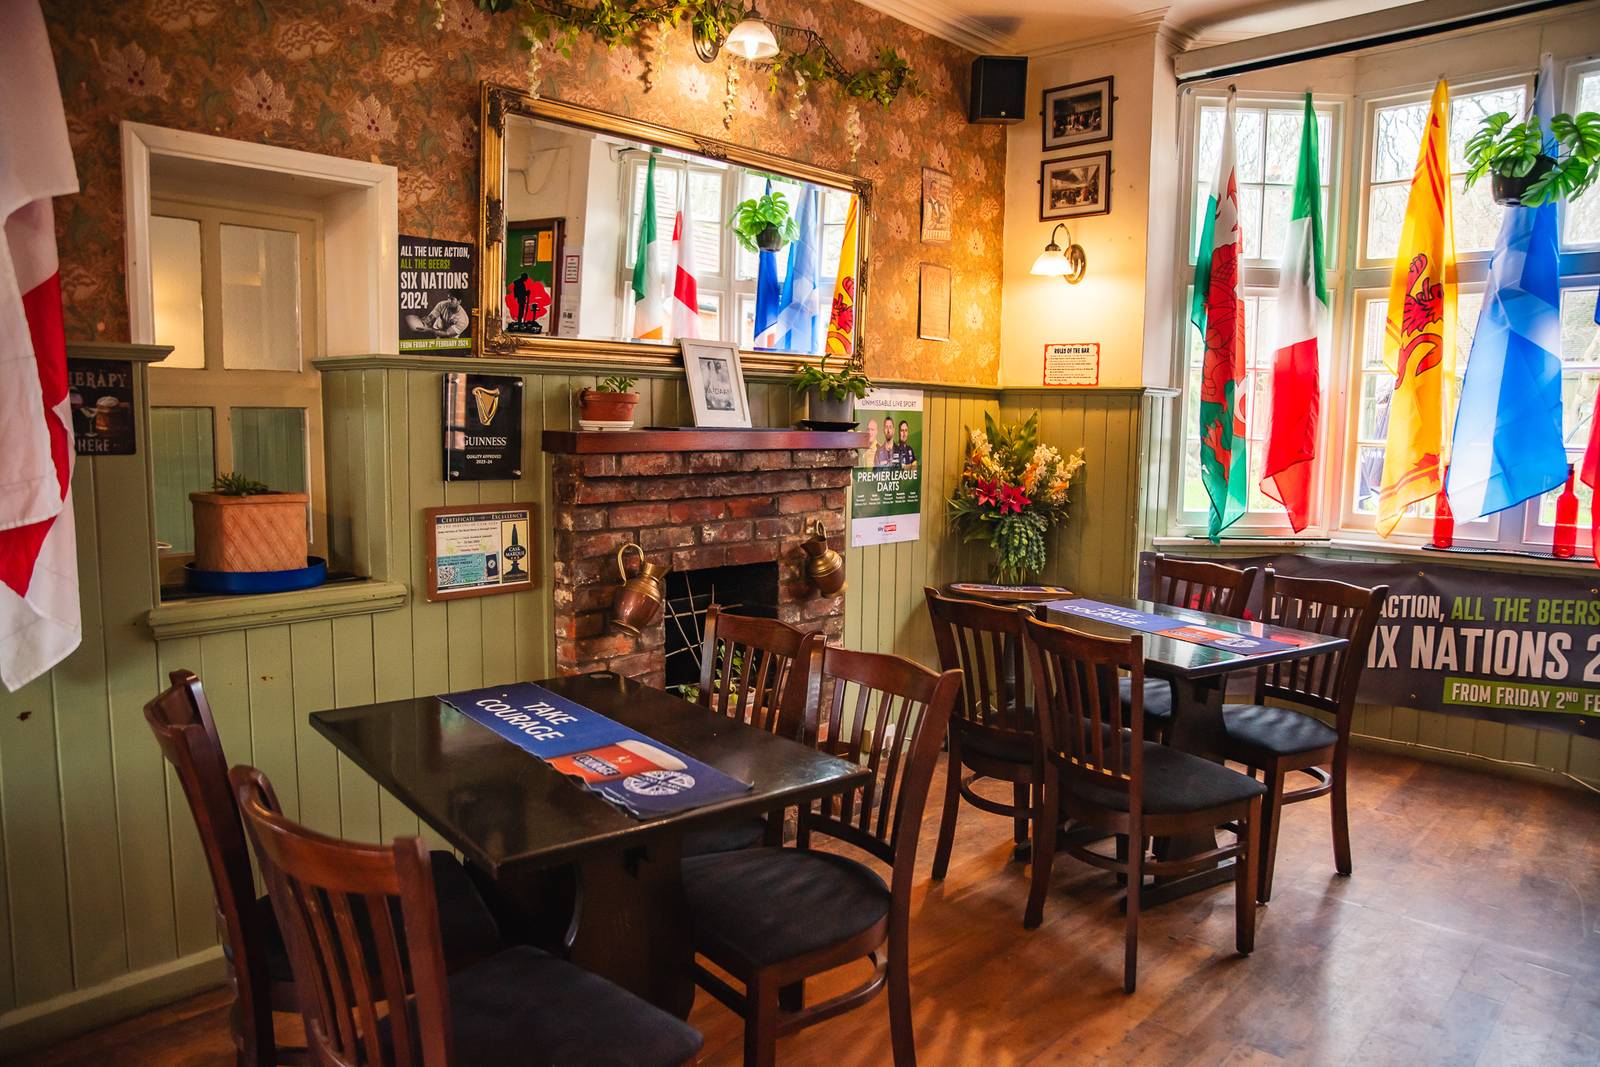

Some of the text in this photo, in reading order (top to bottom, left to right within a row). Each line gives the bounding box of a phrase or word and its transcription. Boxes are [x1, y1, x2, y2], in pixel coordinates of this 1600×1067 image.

[400, 246, 470, 259] ALL THE LIVE ACTION,
[400, 259, 451, 270] ALL THE BEERS!
[400, 272, 469, 290] SIX NATIONS
[400, 291, 429, 310] 2024
[69, 372, 127, 388] ERAPY
[862, 399, 917, 408] UNMISSABLE LIVE SPORT
[78, 439, 109, 452] HERE
[464, 436, 507, 446] GUINNESS
[857, 470, 918, 483] PREMIER LEAGUE
[877, 481, 900, 492] DARTS
[1379, 595, 1445, 623] ACTION,
[1450, 596, 1485, 621] ALL
[1494, 597, 1529, 623] THE
[1367, 625, 1401, 669] IX
[1410, 625, 1573, 680] NATIONS
[1451, 683, 1491, 704] FROM
[1495, 686, 1551, 708] FRIDAY
[475, 698, 565, 742] COURAGE
[523, 701, 579, 725] TAKE
